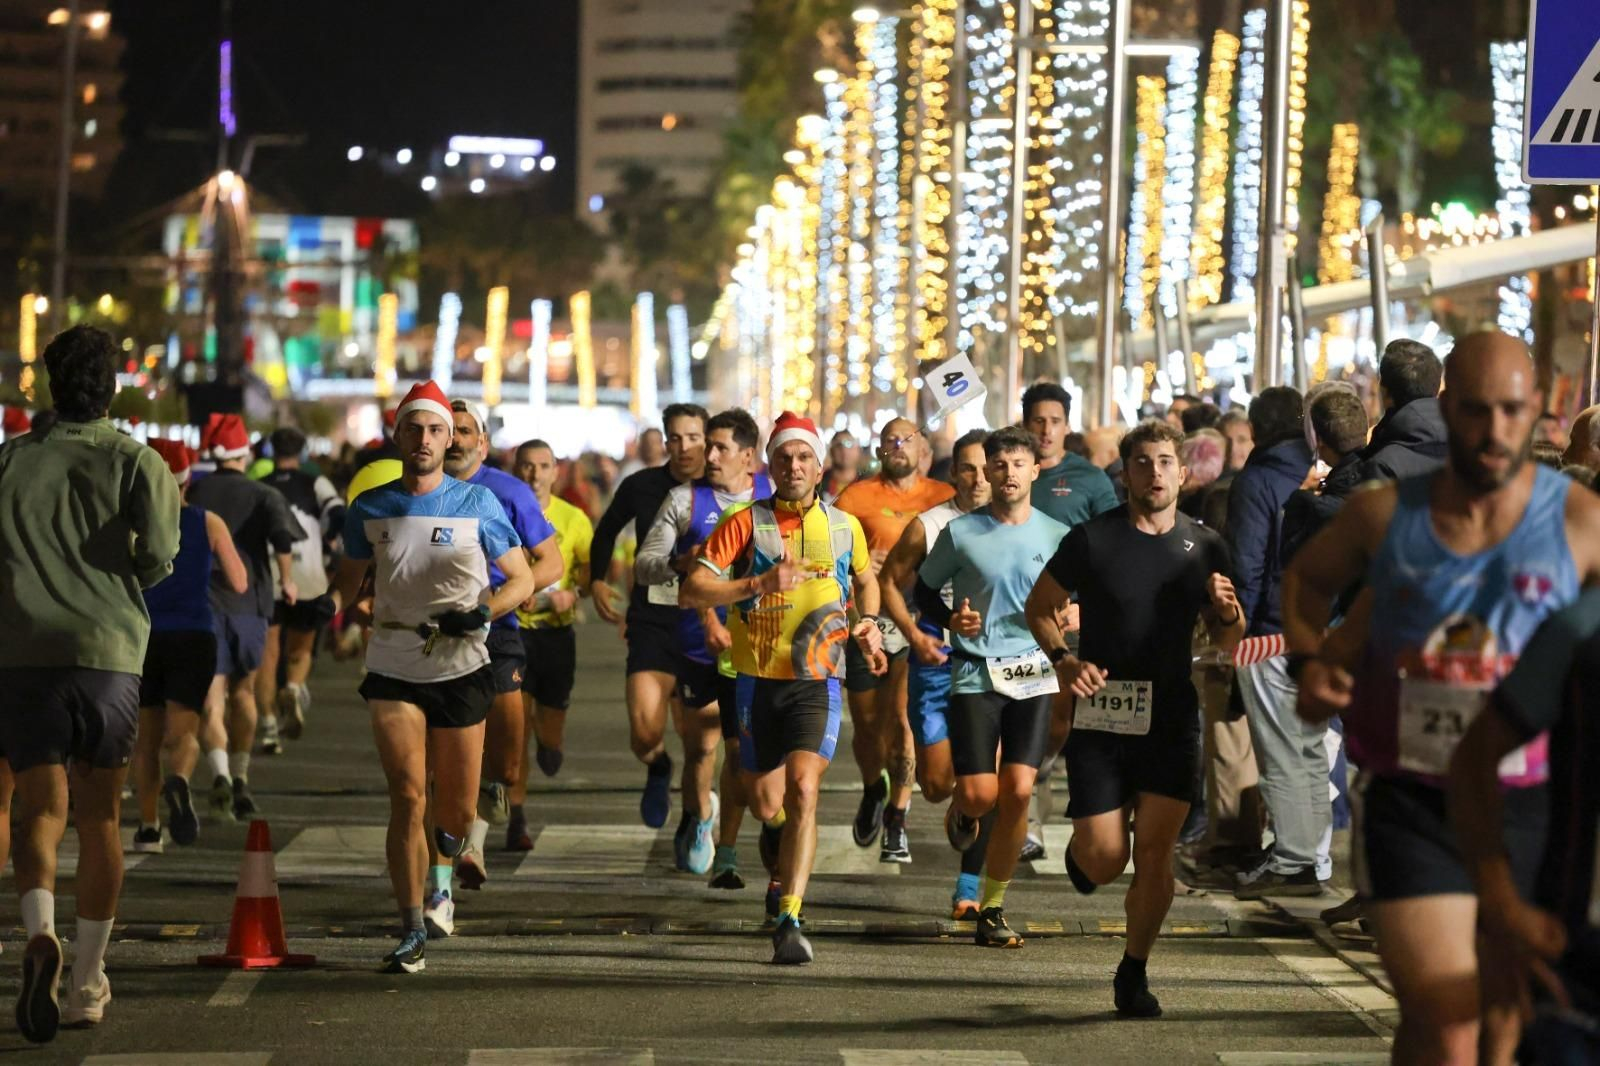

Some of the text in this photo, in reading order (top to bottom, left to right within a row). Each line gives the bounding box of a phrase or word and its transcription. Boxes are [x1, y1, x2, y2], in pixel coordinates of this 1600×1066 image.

[943, 371, 969, 397] 40
[1002, 663, 1036, 681] 342
[1122, 682, 1133, 692] M
[1089, 695, 1133, 711] 1191
